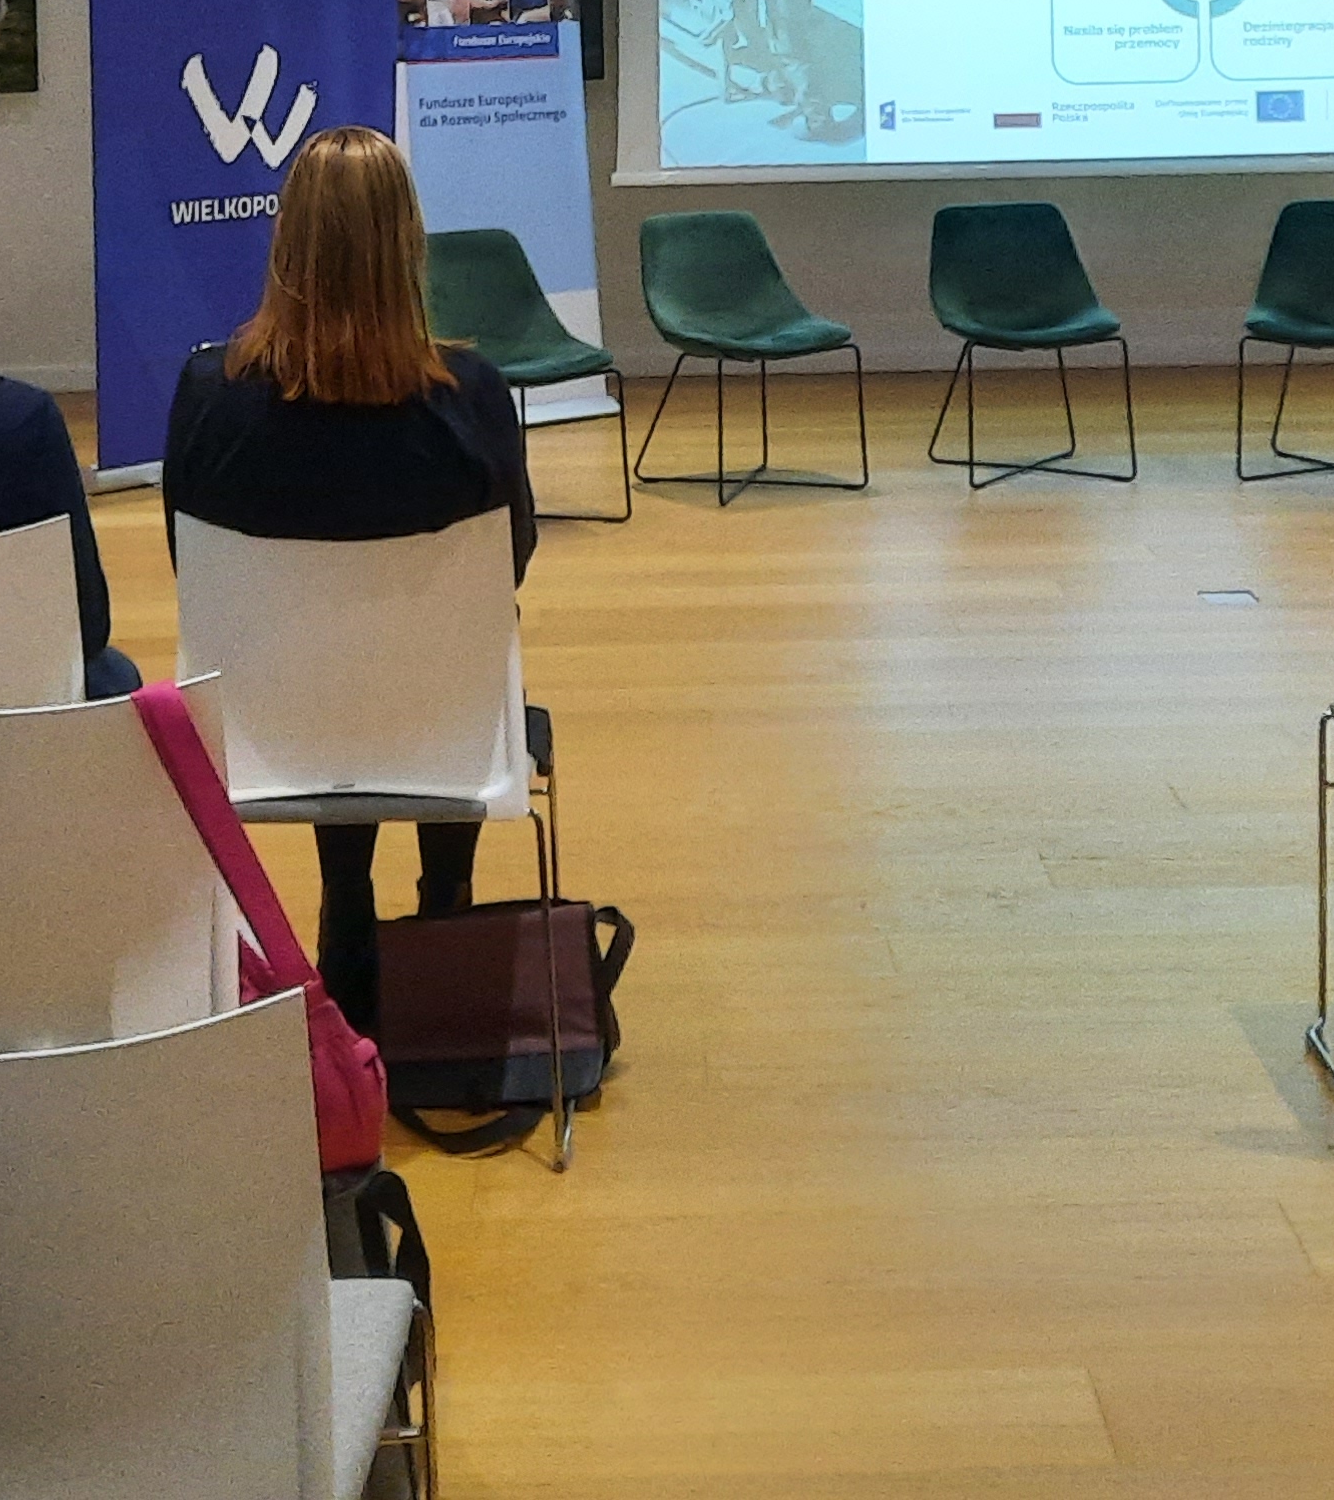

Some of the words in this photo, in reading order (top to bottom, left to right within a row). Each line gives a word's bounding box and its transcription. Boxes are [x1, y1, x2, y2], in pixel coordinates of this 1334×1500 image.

[1114, 38, 1181, 51] przemocy
[1243, 35, 1293, 48] rodziny
[419, 96, 475, 110] Fundusze
[420, 115, 438, 127] dla
[171, 193, 280, 225] WIELKOPO
